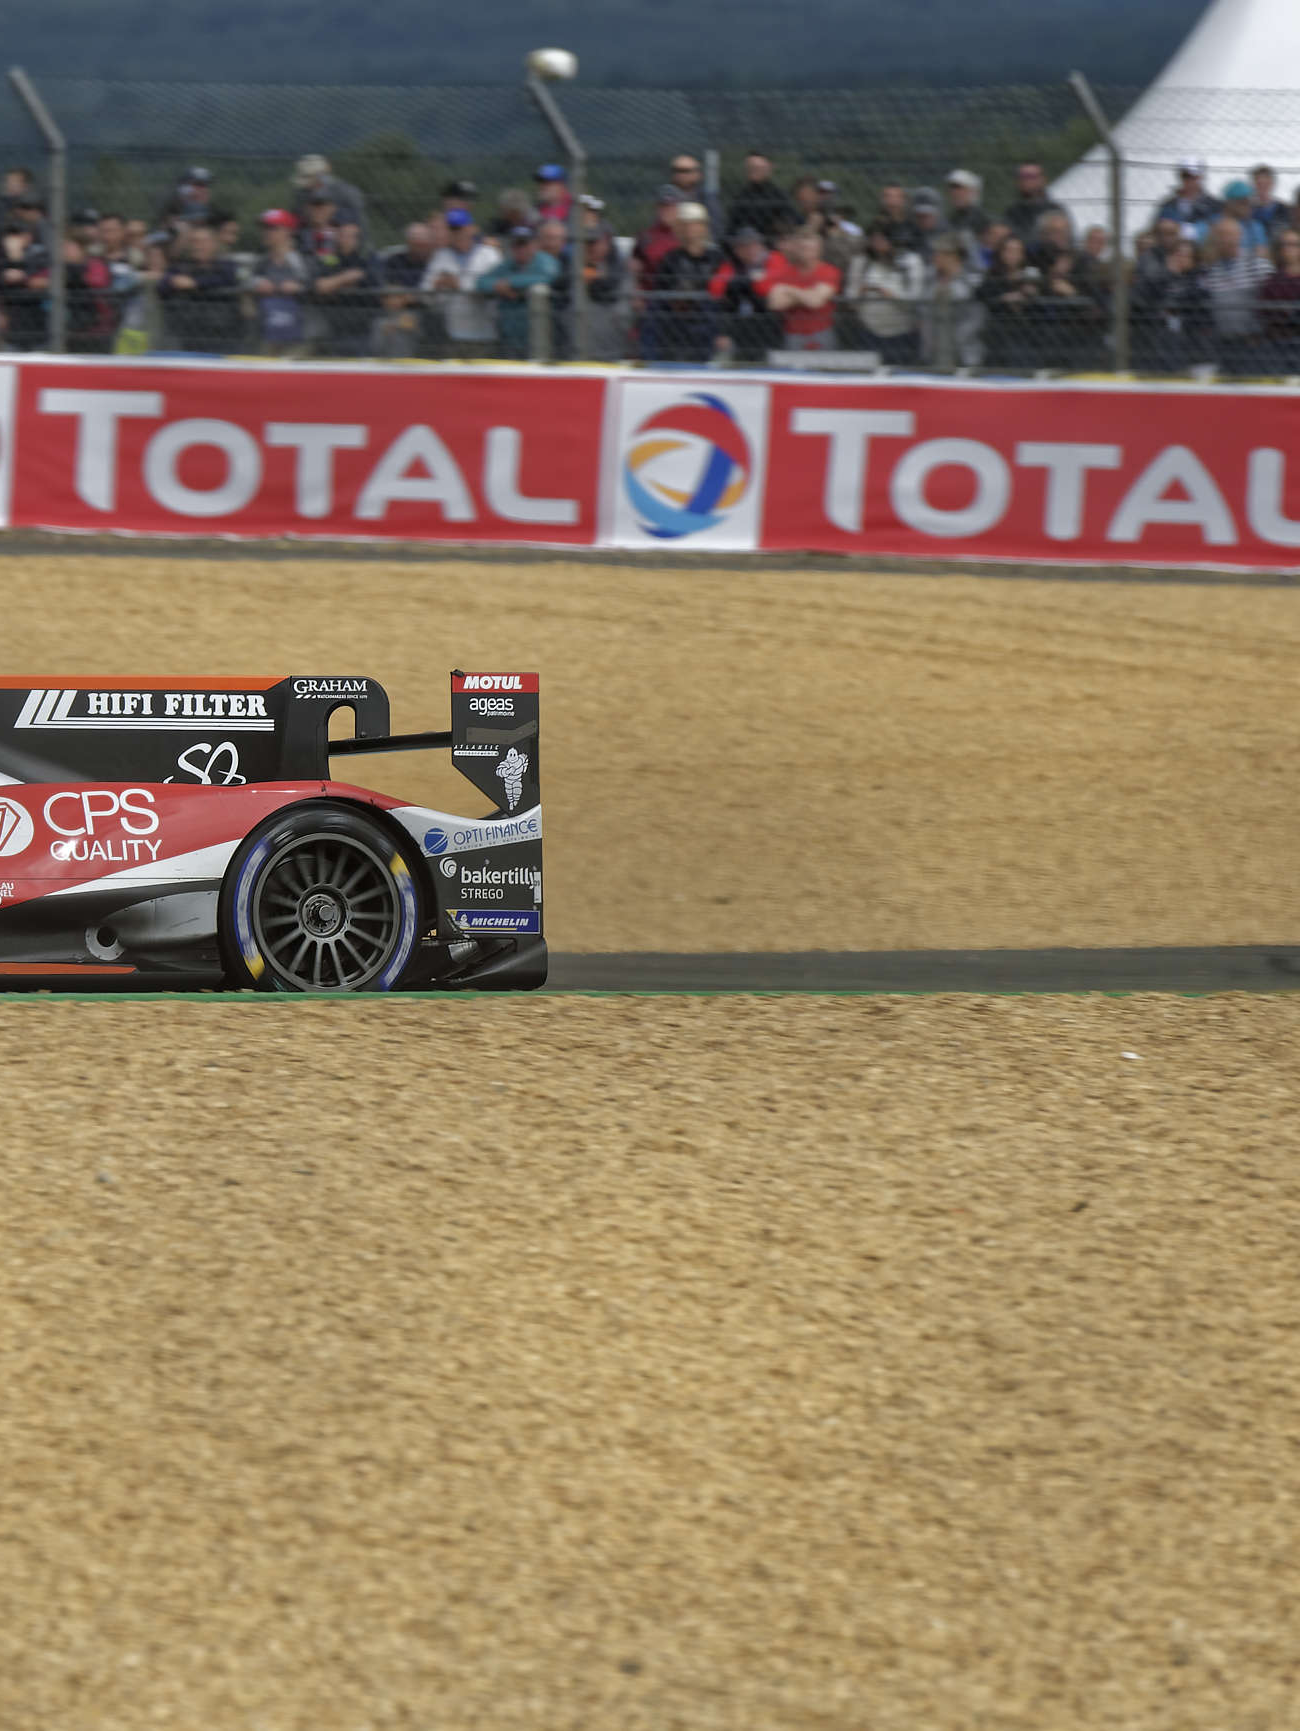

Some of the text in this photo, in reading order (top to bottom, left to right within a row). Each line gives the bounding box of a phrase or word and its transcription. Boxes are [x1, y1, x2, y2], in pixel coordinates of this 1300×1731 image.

[293, 679, 368, 694] GRAHAM
[463, 675, 523, 690] MOTUL
[87, 693, 267, 717] HIFI FILTER
[469, 697, 515, 716] ageas
[43, 788, 160, 836] CPS
[453, 828, 483, 846] OPTI
[50, 839, 162, 861] QUALITY
[461, 888, 504, 900] STREGO
[471, 917, 529, 926] MICHELIN
